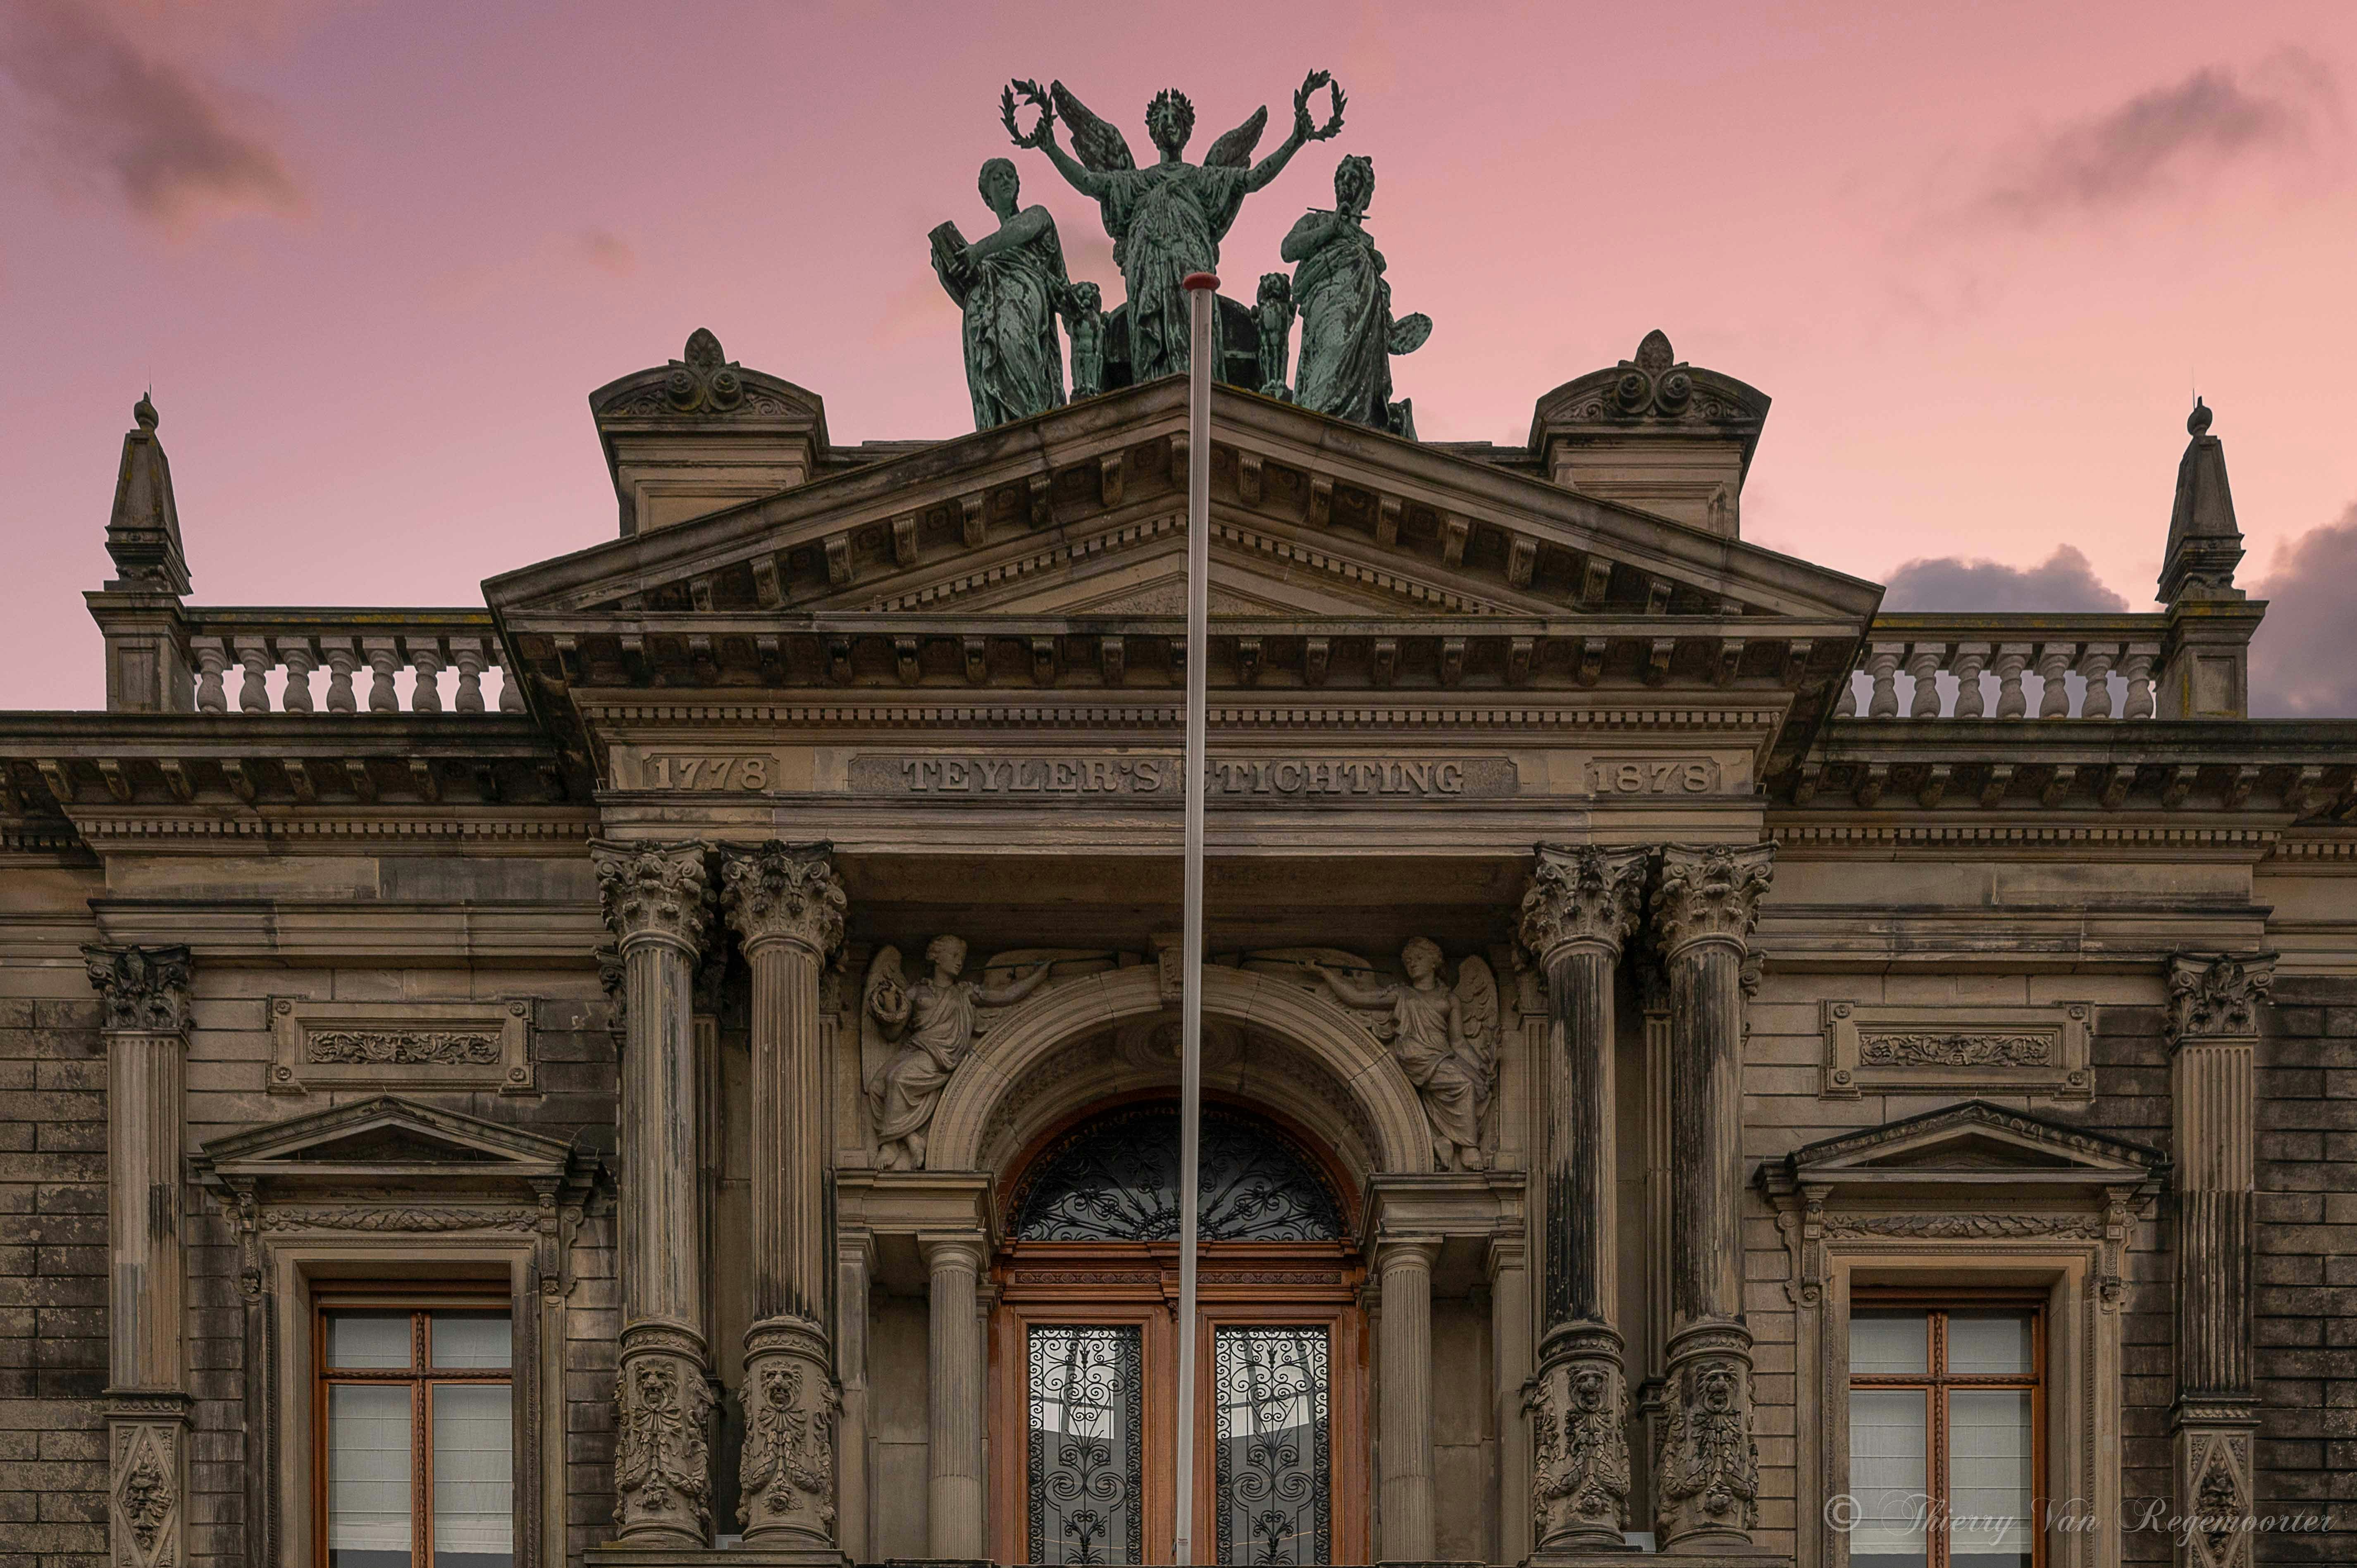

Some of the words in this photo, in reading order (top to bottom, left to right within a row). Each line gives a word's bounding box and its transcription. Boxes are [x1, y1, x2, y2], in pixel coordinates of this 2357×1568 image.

[656, 758, 768, 790] 1778
[902, 759, 1162, 792] TEYLER'S
[1593, 762, 1711, 794] 1878
